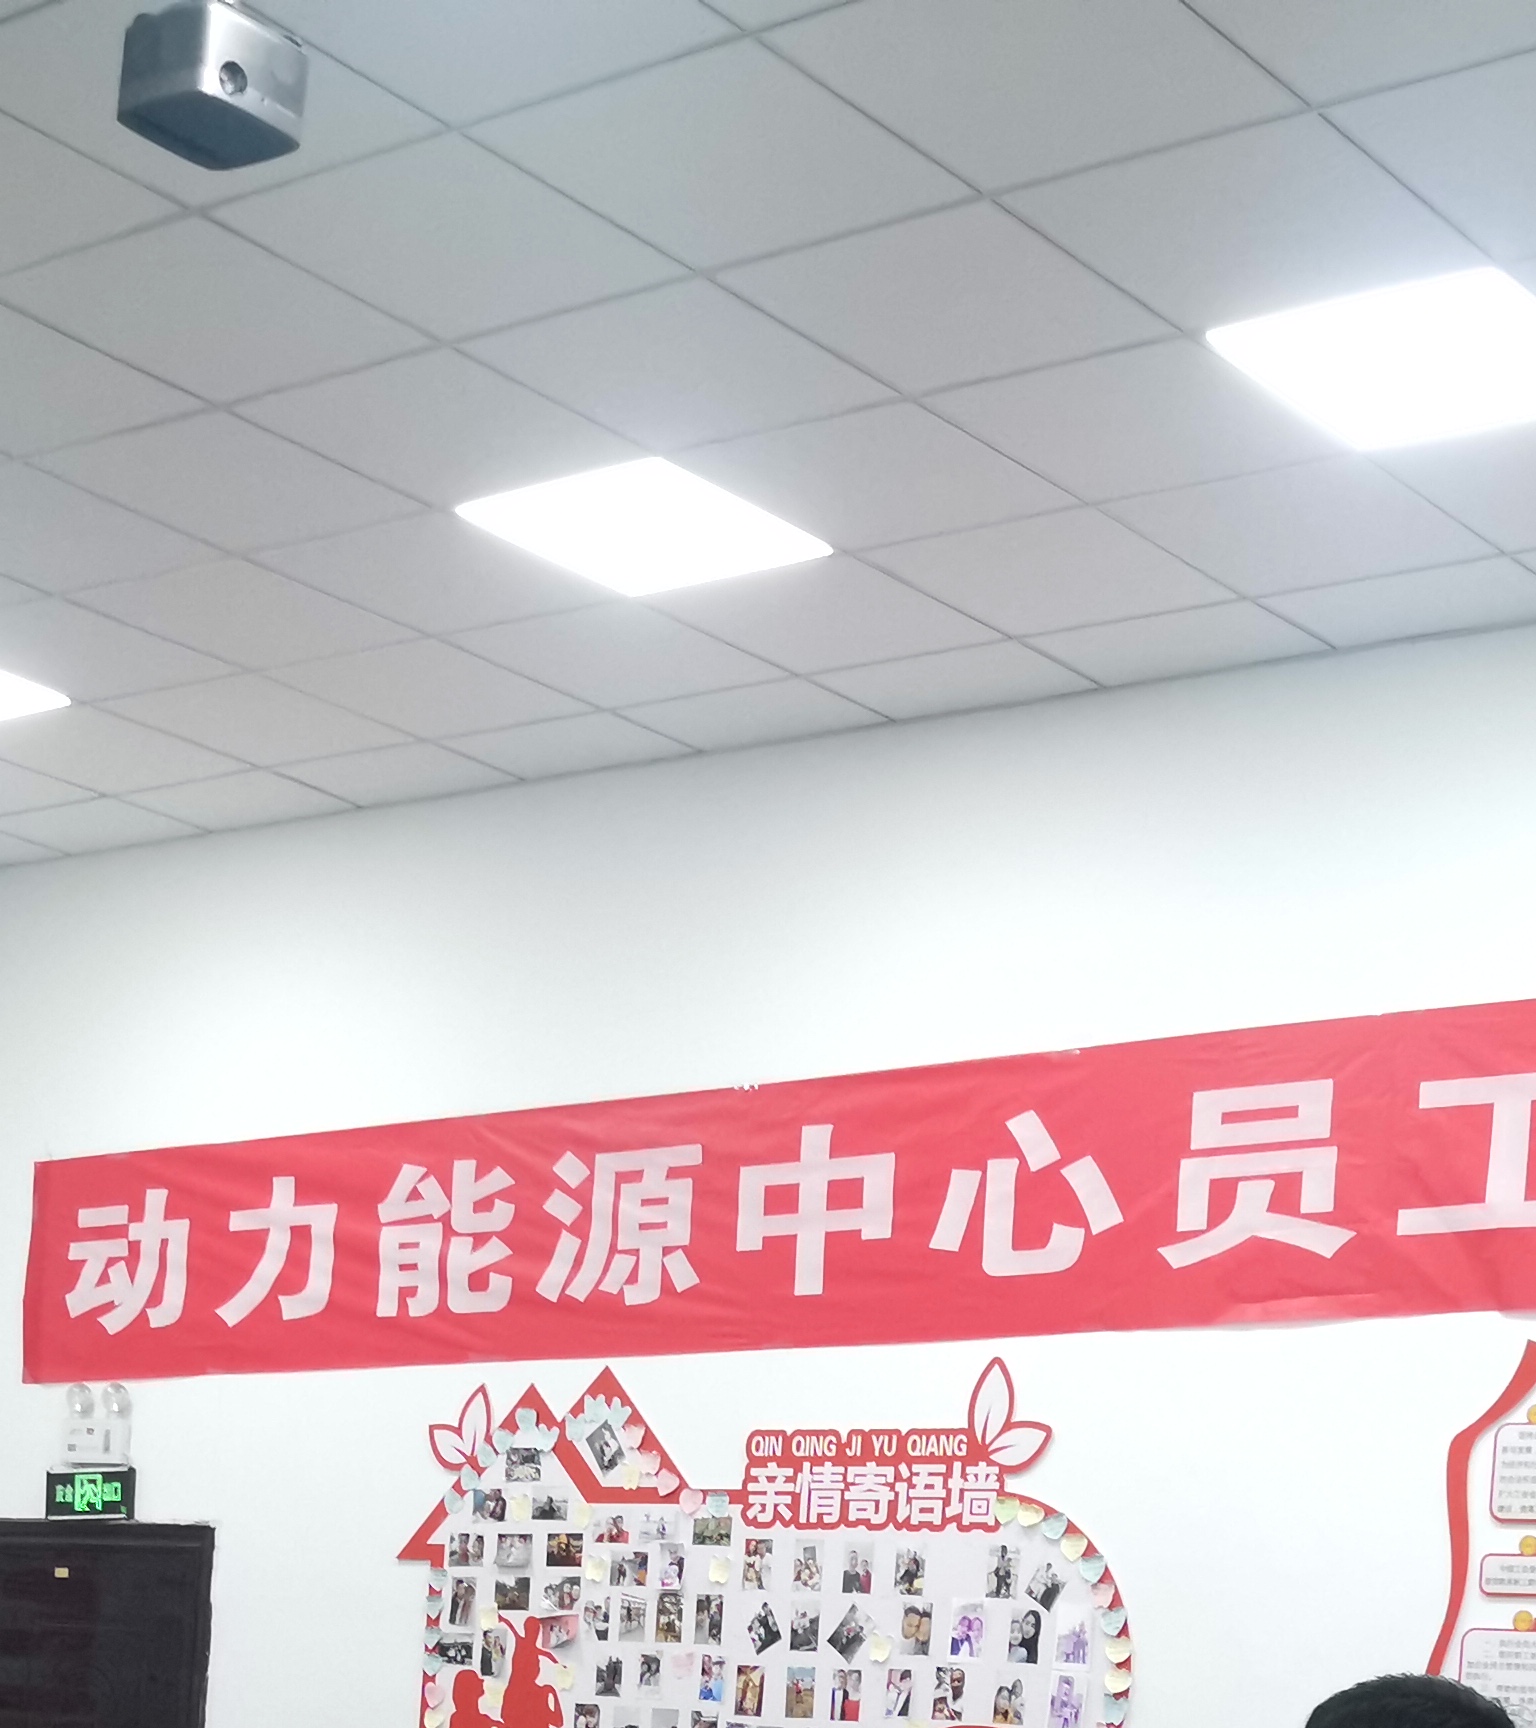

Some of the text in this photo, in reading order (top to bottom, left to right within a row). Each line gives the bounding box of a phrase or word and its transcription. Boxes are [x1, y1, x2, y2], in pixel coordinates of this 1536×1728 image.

[750, 1433, 968, 1458] QIN QING JI YU QIANG
[745, 1461, 1001, 1527] 亲情寄语墙
